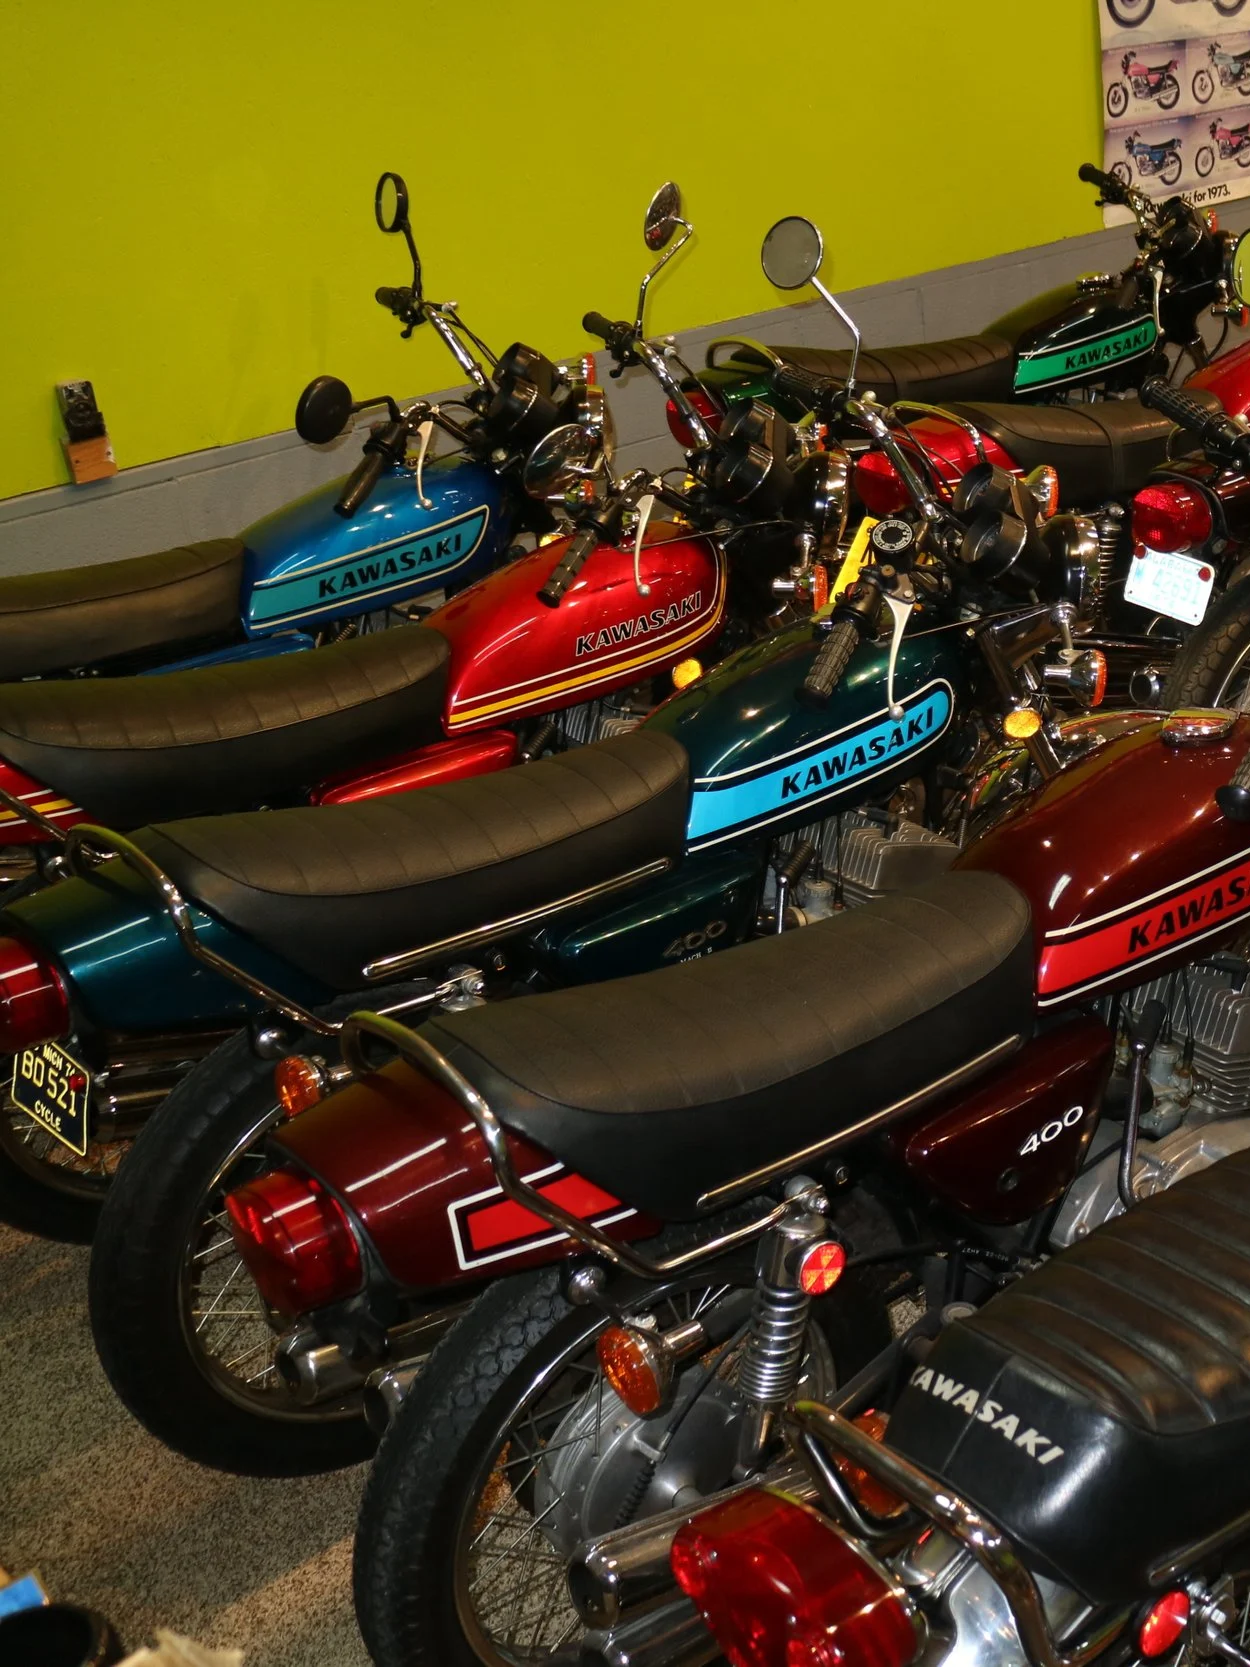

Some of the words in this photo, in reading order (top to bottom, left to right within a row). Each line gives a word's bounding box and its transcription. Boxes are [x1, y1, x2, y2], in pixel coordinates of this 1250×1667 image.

[1193, 190, 1206, 203] for
[1207, 183, 1231, 200] 1973.
[1065, 329, 1149, 370] KAWASAKI
[318, 533, 462, 598] KAWASAKI
[575, 590, 702, 657] KAWASAKI
[781, 706, 935, 799] KAWASAKI
[43, 1044, 64, 1071] MICH
[34, 1099, 62, 1133] CYCLE
[1018, 1105, 1084, 1156] 400
